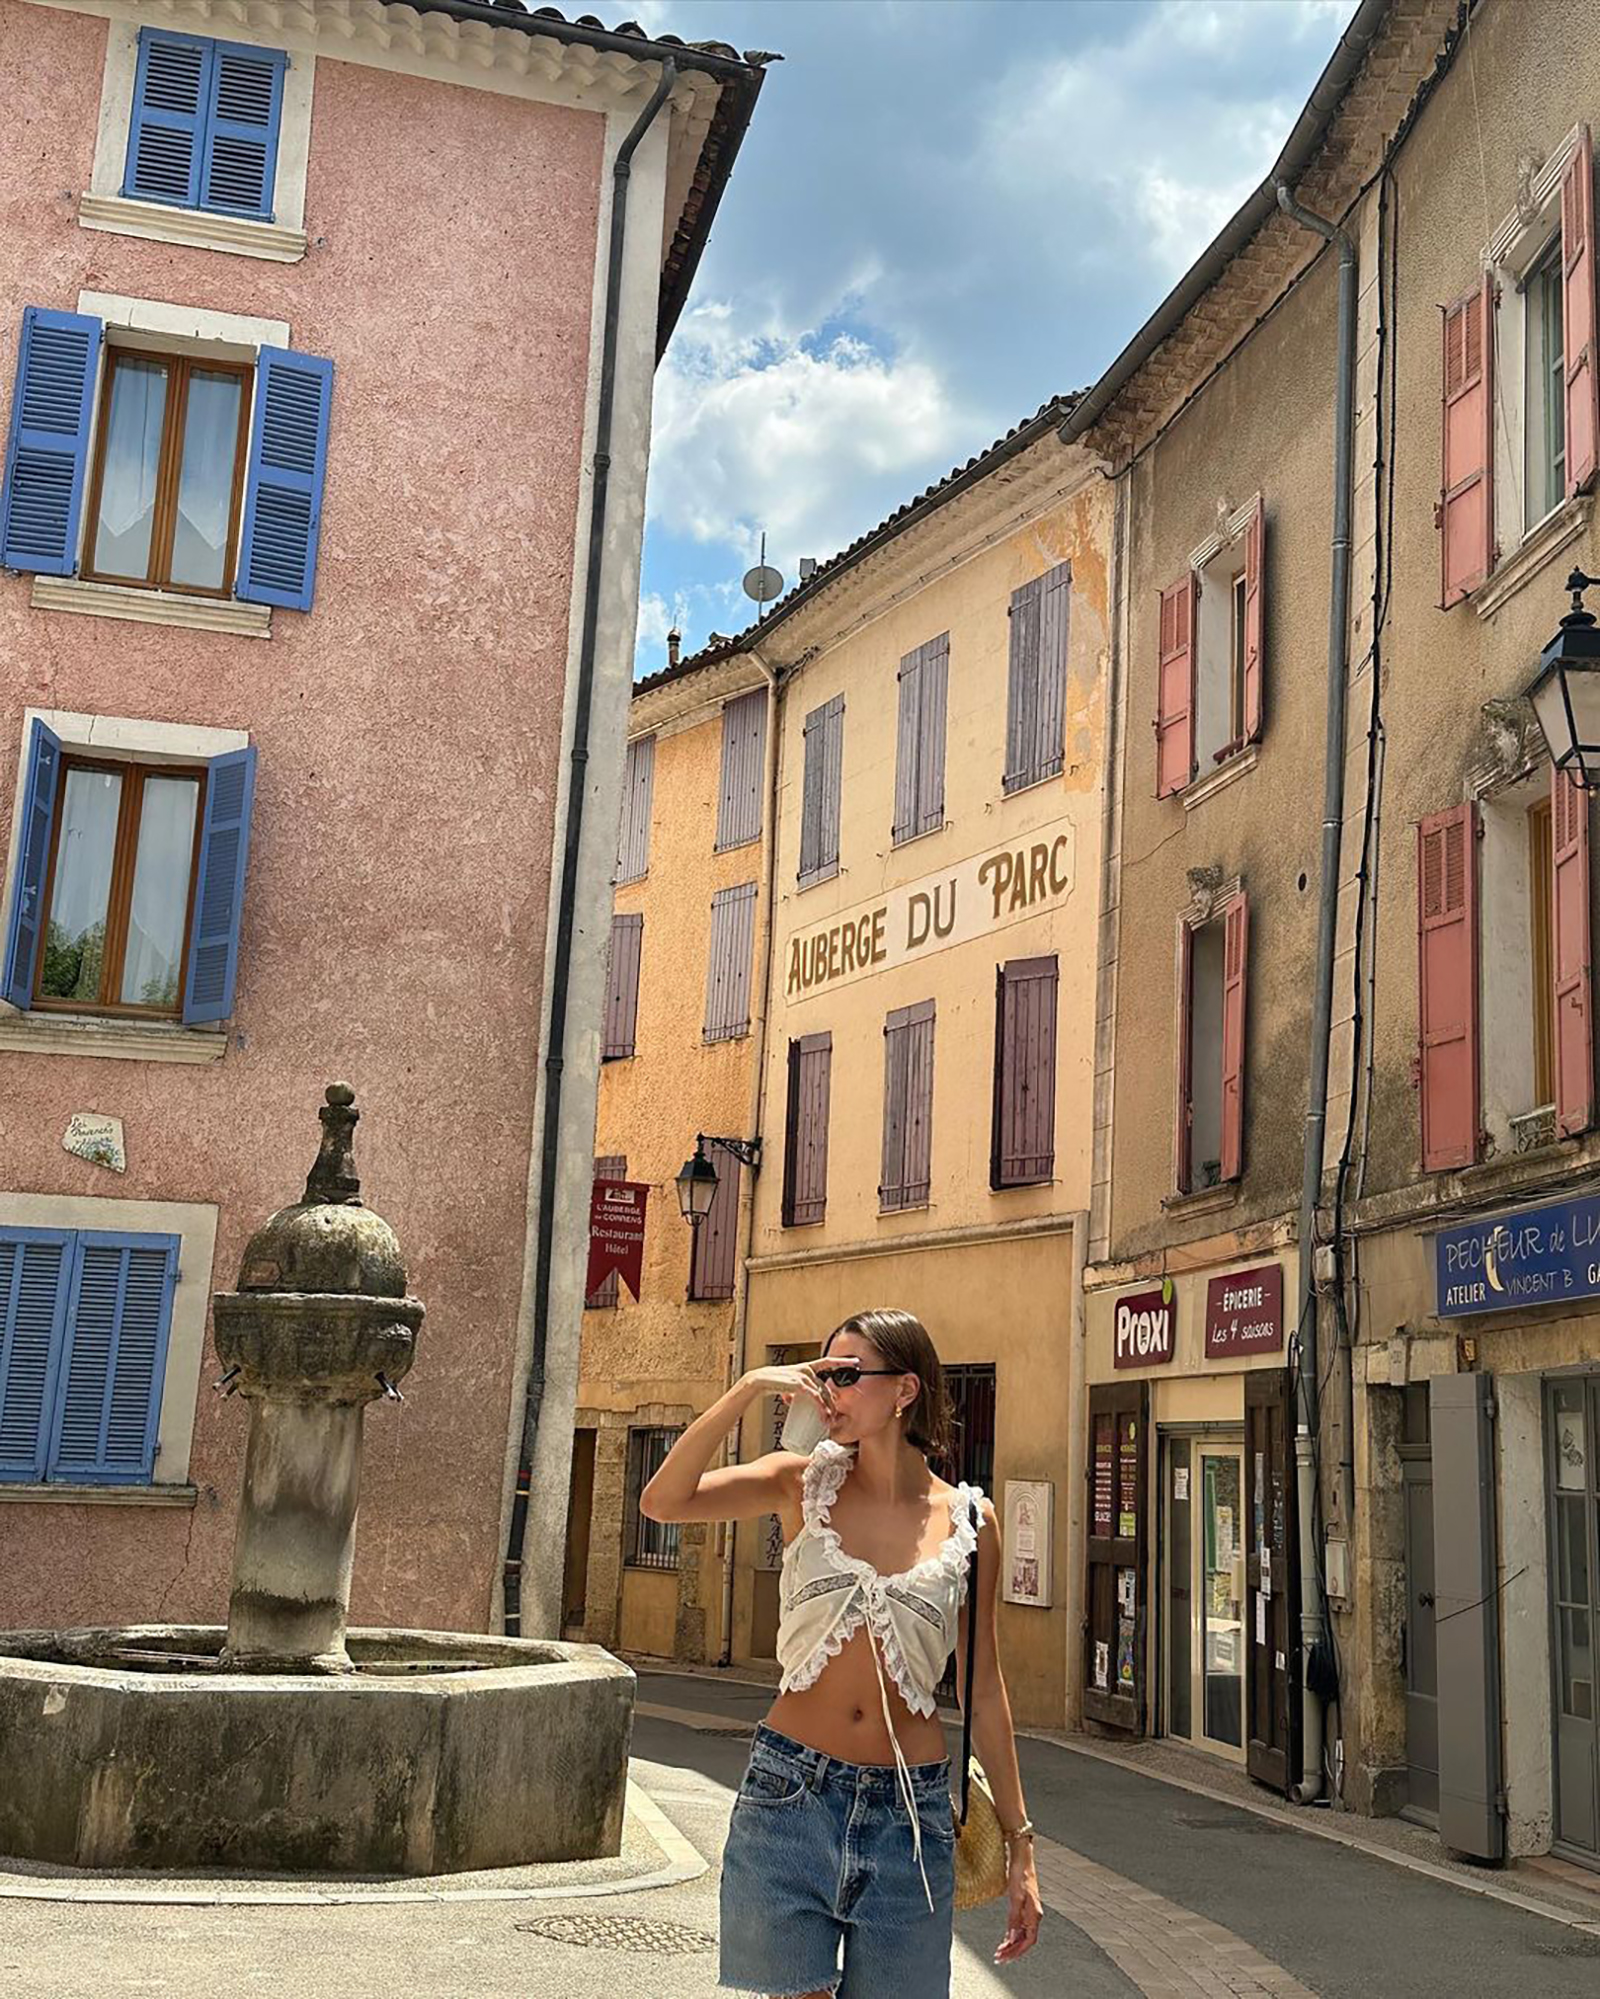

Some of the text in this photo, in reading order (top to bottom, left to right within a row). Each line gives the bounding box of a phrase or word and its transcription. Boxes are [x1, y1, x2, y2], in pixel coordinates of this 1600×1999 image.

[787, 835, 1069, 996] AUBERGE DU PARC
[592, 1226, 643, 1240] Restaurant
[1550, 1223, 1566, 1252] de
[605, 1243, 629, 1255] Hôtel
[1223, 1286, 1264, 1312] ÉPICERIE
[1446, 1283, 1487, 1306] ATELIER
[1506, 1271, 1558, 1297] VINCENT
[1562, 1269, 1574, 1289] B
[1212, 1319, 1274, 1343] Les 4 saisons
